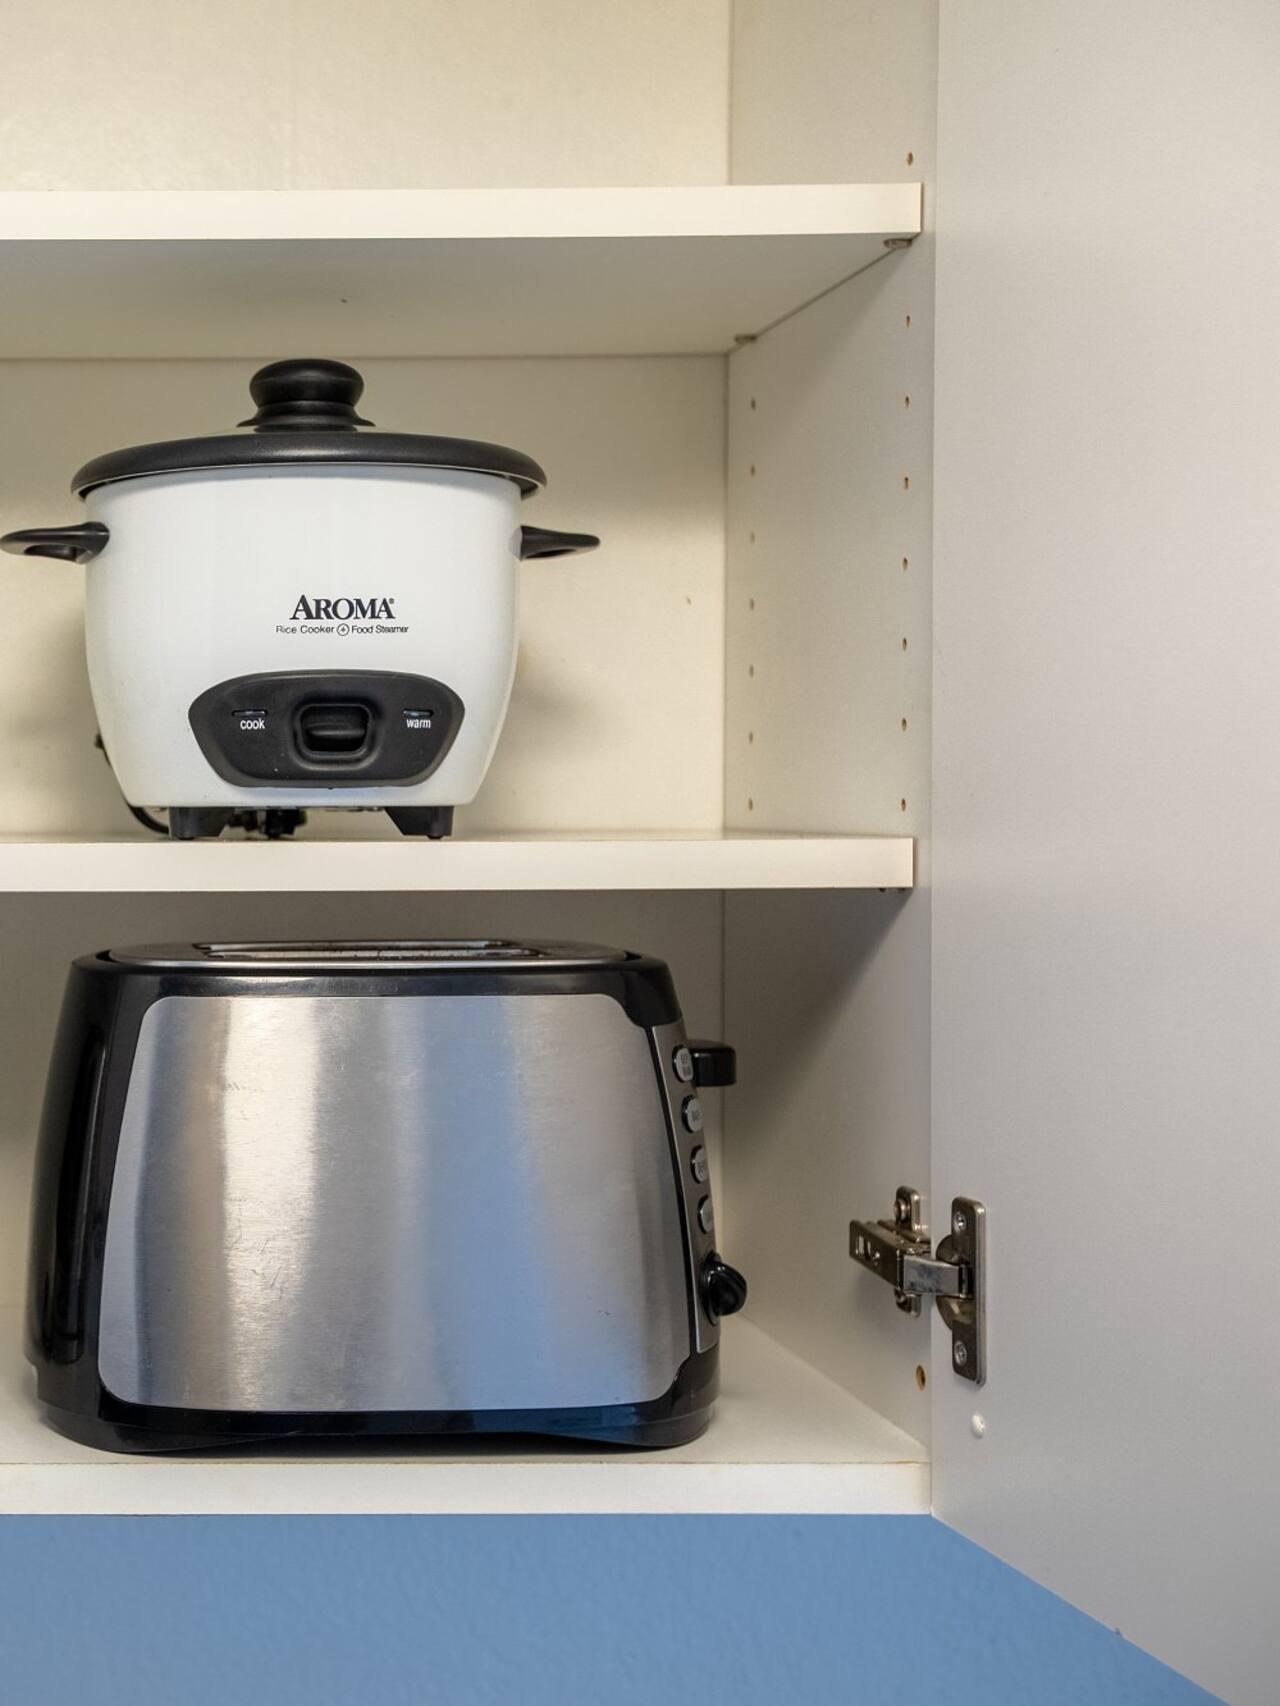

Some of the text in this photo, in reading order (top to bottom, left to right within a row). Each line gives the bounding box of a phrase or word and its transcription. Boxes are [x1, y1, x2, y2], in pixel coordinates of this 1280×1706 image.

[289, 594, 396, 620] AROMA
[276, 625, 409, 634] Rice Cooker Food Steamer
[240, 718, 432, 730] cook warm
